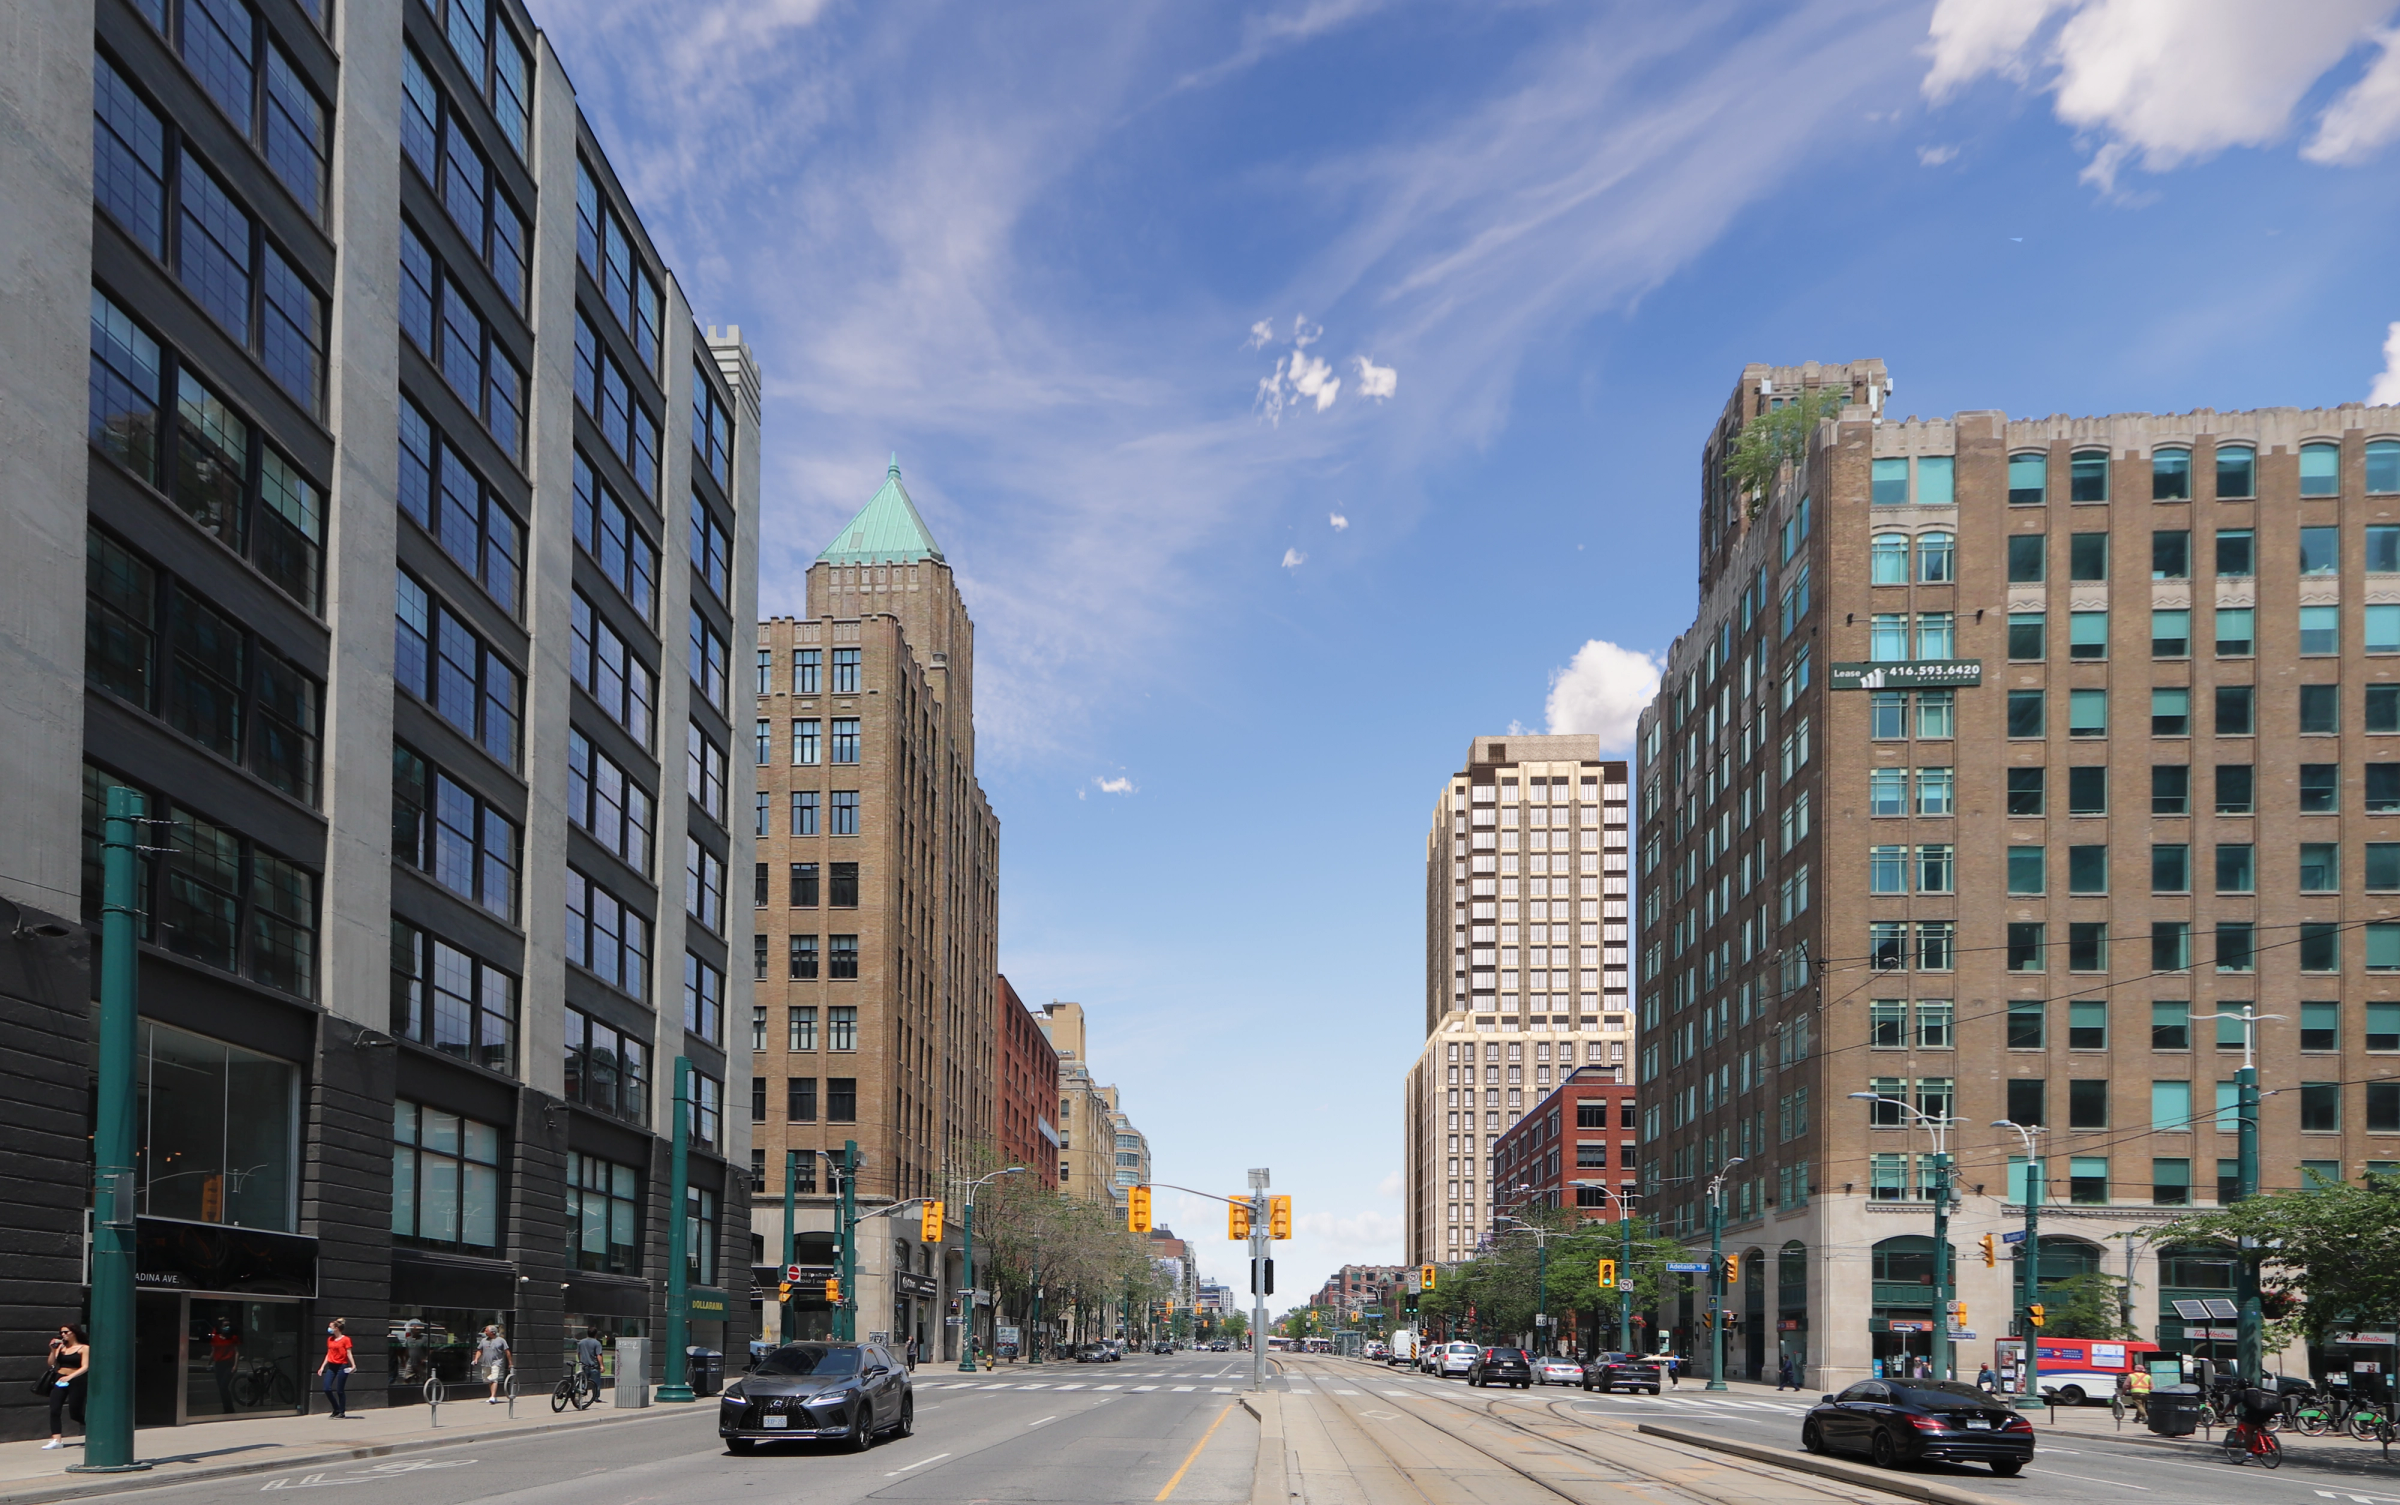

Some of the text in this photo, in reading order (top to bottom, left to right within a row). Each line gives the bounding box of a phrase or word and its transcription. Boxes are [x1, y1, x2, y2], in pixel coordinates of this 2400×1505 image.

[1833, 665, 1980, 678] Lease 416.593.6420
[135, 1272, 180, 1284] ADINA AVE.
[692, 1300, 724, 1311] DOLLARAMA
[2208, 1329, 2235, 1338] Hortons
[2360, 1334, 2388, 1343] Hortons
